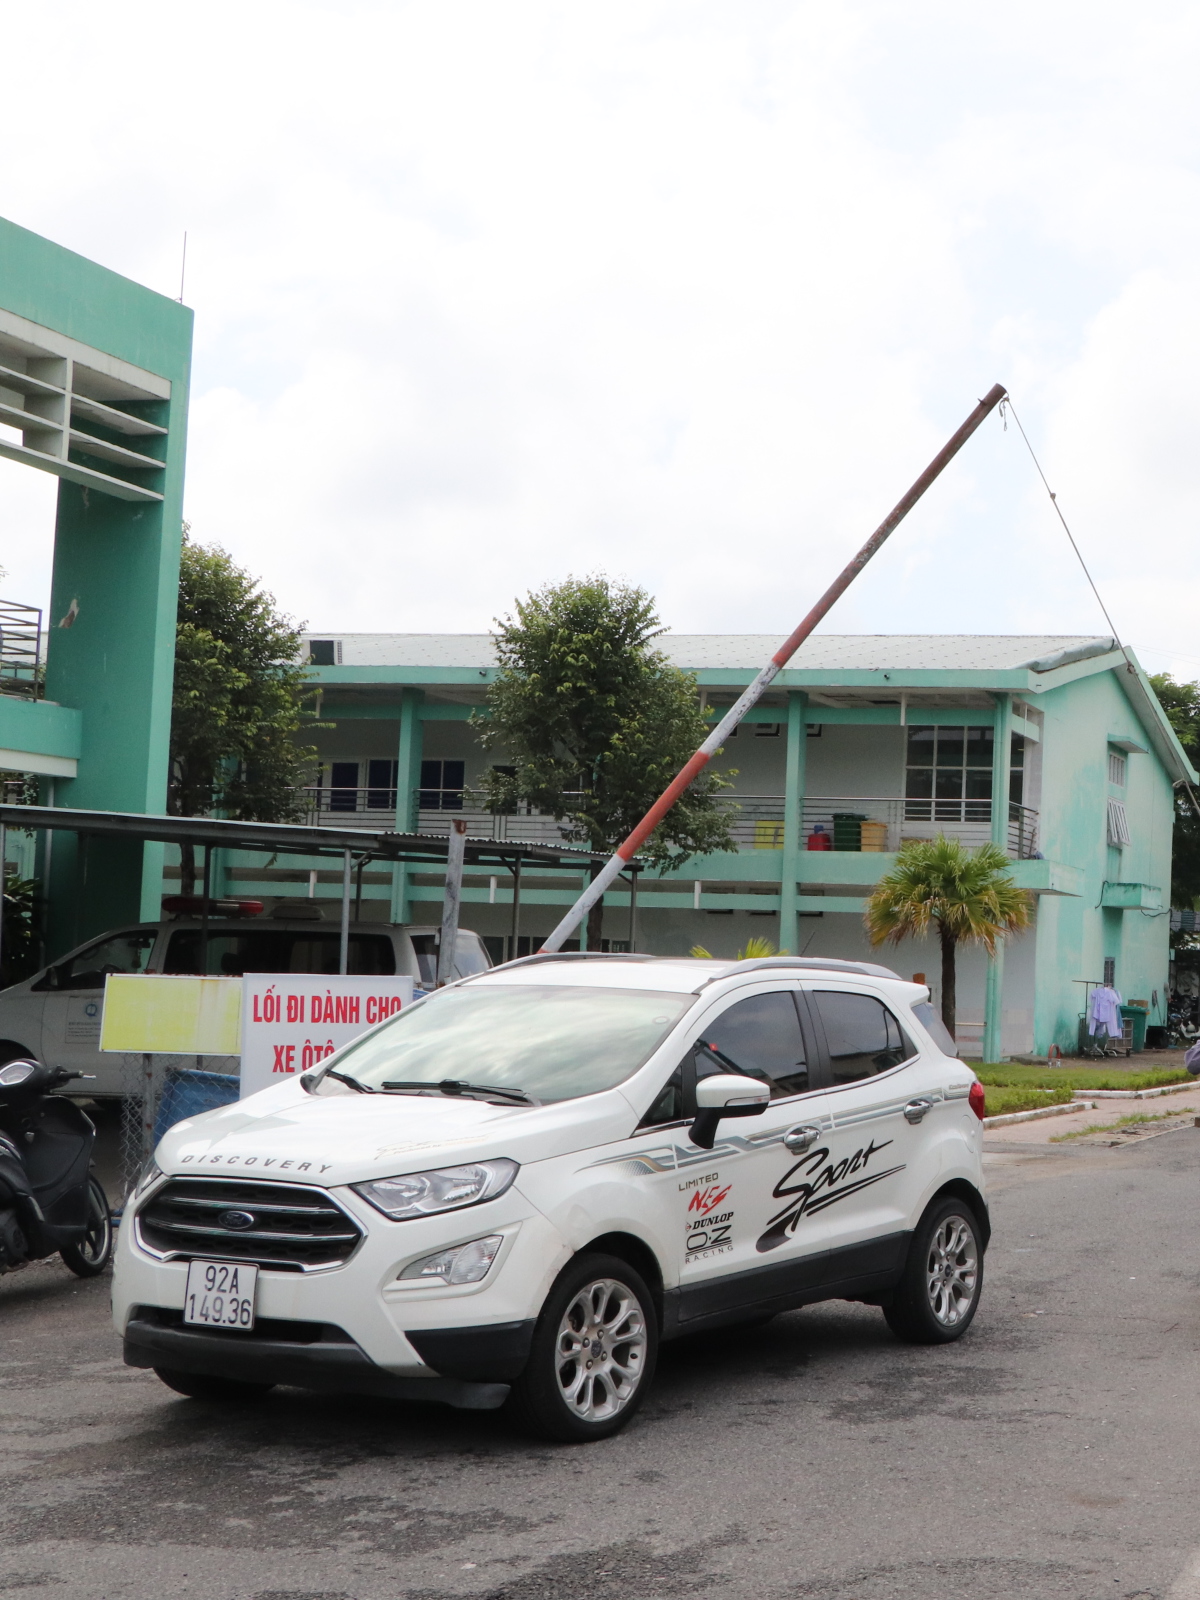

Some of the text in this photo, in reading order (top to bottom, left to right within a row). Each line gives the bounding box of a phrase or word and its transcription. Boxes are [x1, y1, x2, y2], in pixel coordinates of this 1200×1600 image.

[253, 985, 401, 1024] LỐI ĐI DÀNH CHO
[273, 1045, 295, 1072] XE
[181, 1154, 333, 1174] DISCOVERY
[678, 1172, 719, 1191] LIMITED
[692, 1212, 734, 1230] DUNLOP
[685, 1245, 734, 1264] RACING
[204, 1265, 239, 1294] 92A
[189, 1293, 251, 1326] 149.36
